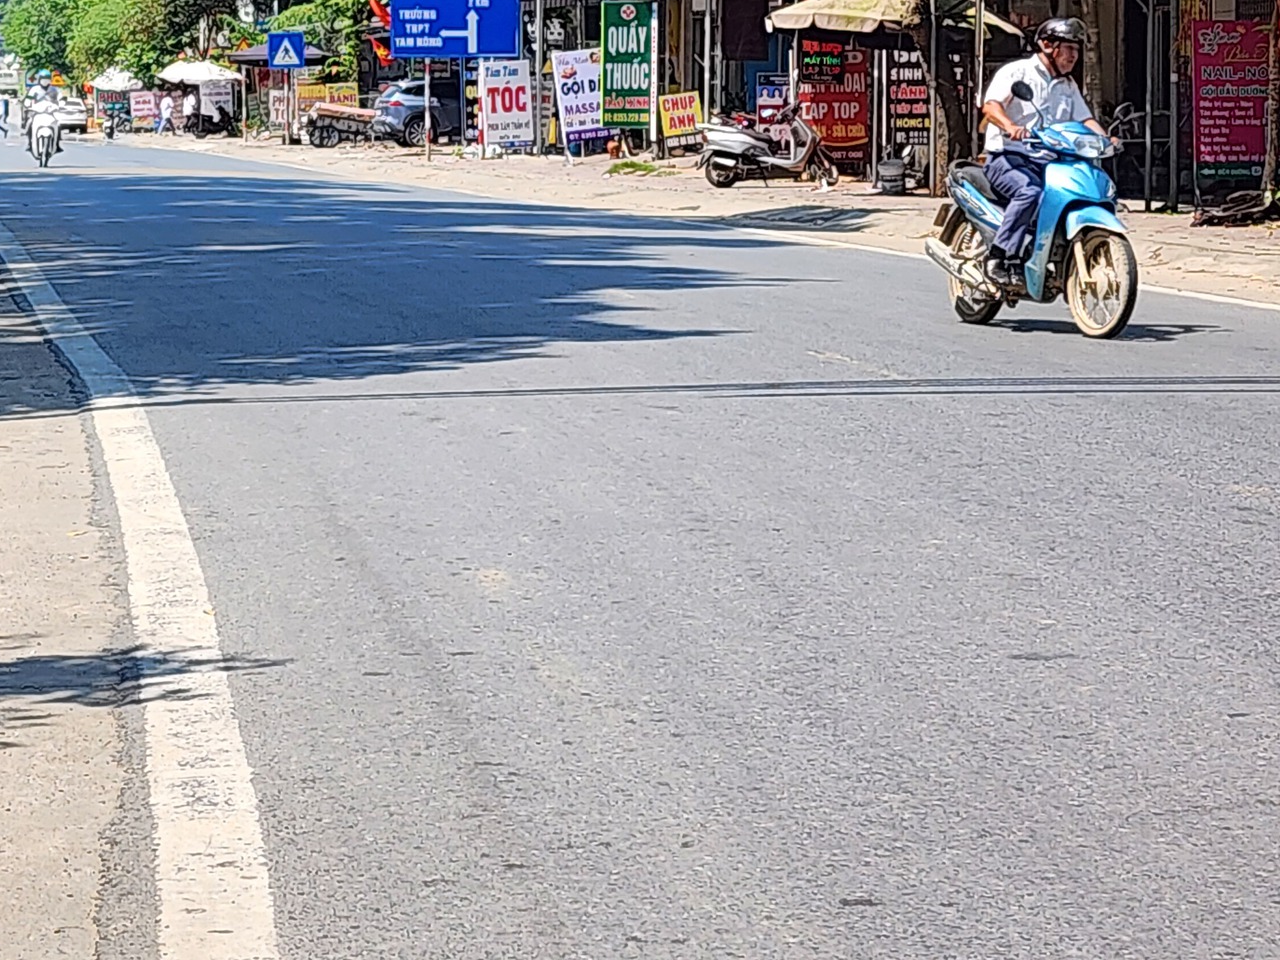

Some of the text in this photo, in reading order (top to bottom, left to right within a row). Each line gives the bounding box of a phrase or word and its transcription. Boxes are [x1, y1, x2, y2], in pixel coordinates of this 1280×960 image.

[605, 56, 649, 90] THUỐC
[487, 80, 528, 114] TÓC
[561, 77, 585, 100] GỘI
[800, 102, 860, 119] LAP TOP
